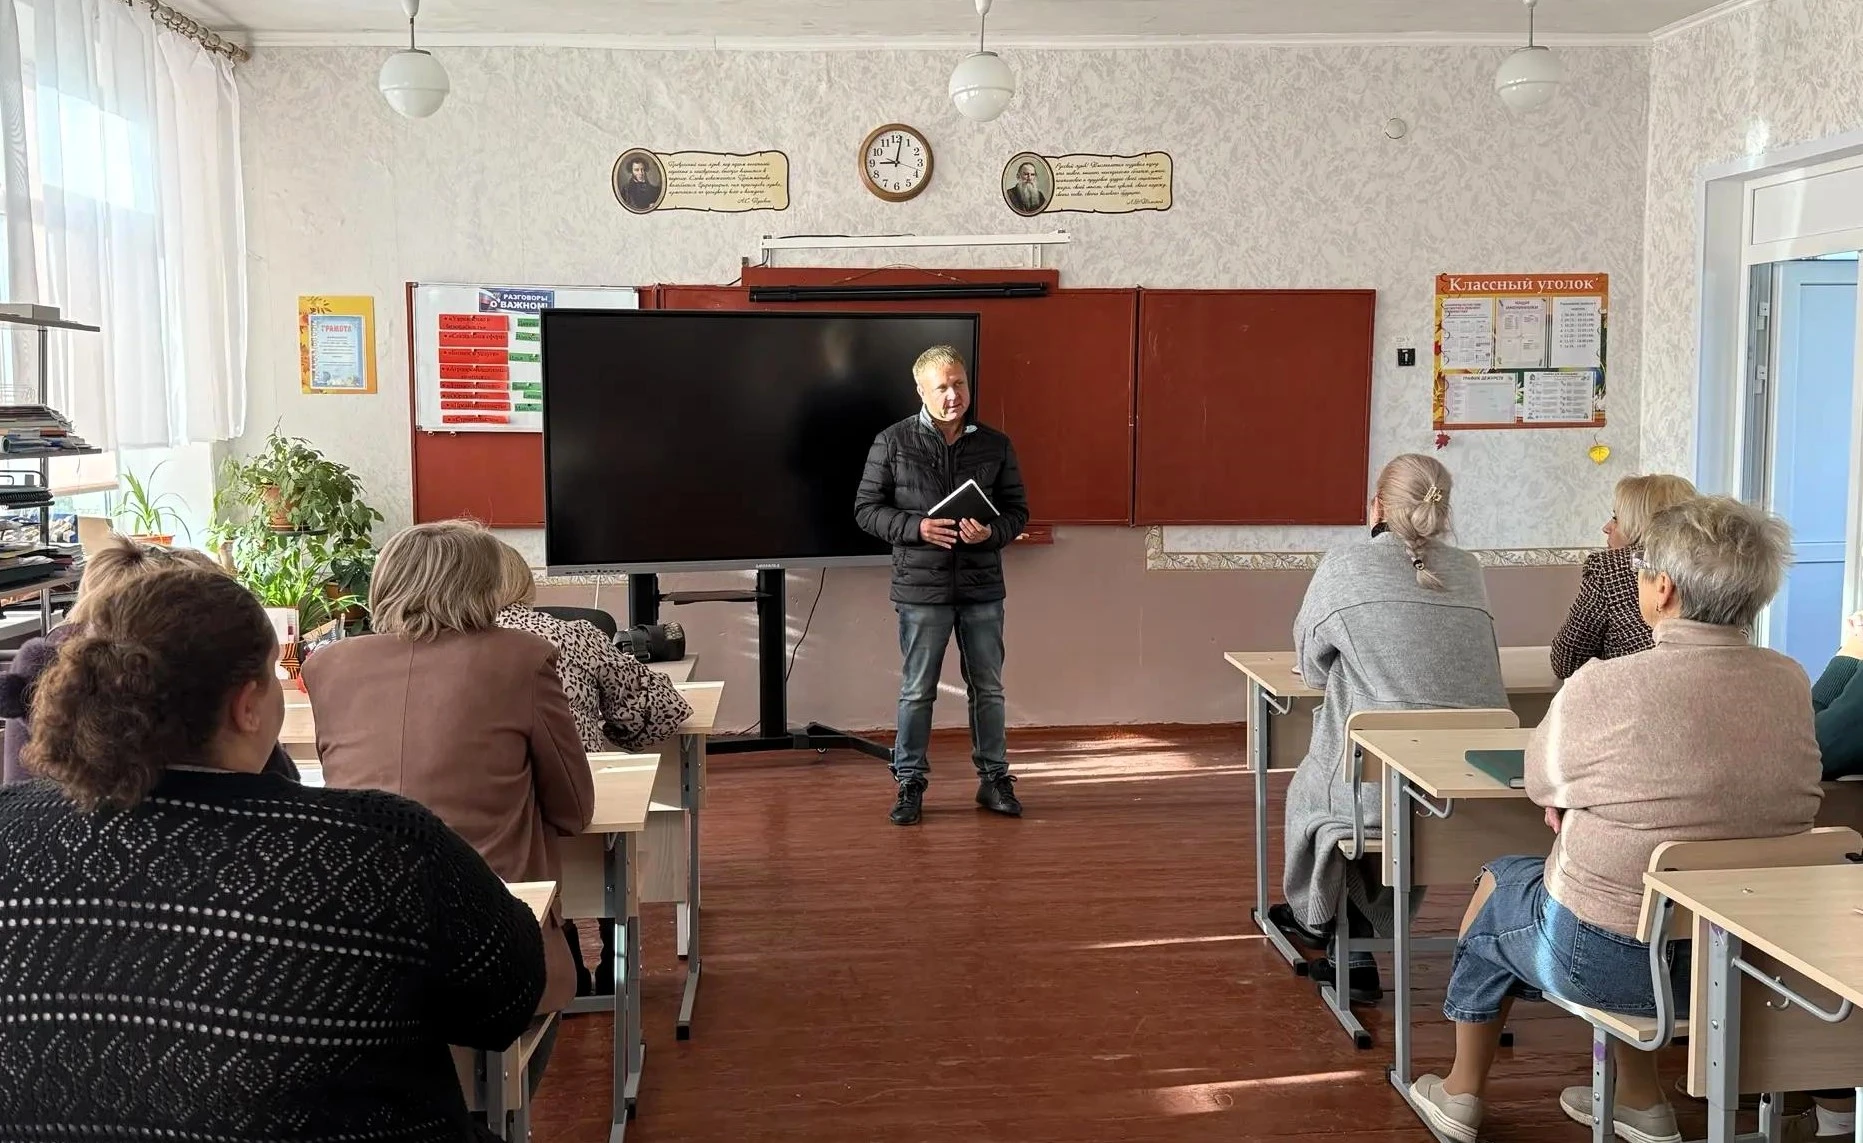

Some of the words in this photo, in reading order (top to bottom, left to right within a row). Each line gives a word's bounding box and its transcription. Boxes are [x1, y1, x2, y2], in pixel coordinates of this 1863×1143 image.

[881, 139, 890, 148] 11
[906, 138, 910, 147] 1
[873, 148, 883, 156] 10
[914, 148, 920, 156] 2
[869, 159, 876, 168] 9
[917, 159, 924, 167] 3
[873, 170, 880, 178] 8
[913, 170, 918, 178] 4
[882, 179, 888, 188] 7
[894, 182, 900, 190] 6
[906, 179, 912, 187] 5
[1450, 277, 1533, 292] Классный
[1537, 278, 1594, 293] уголок
[500, 300, 548, 309] ВАЖНОМ!
[321, 324, 352, 332] ГРАМОТА
